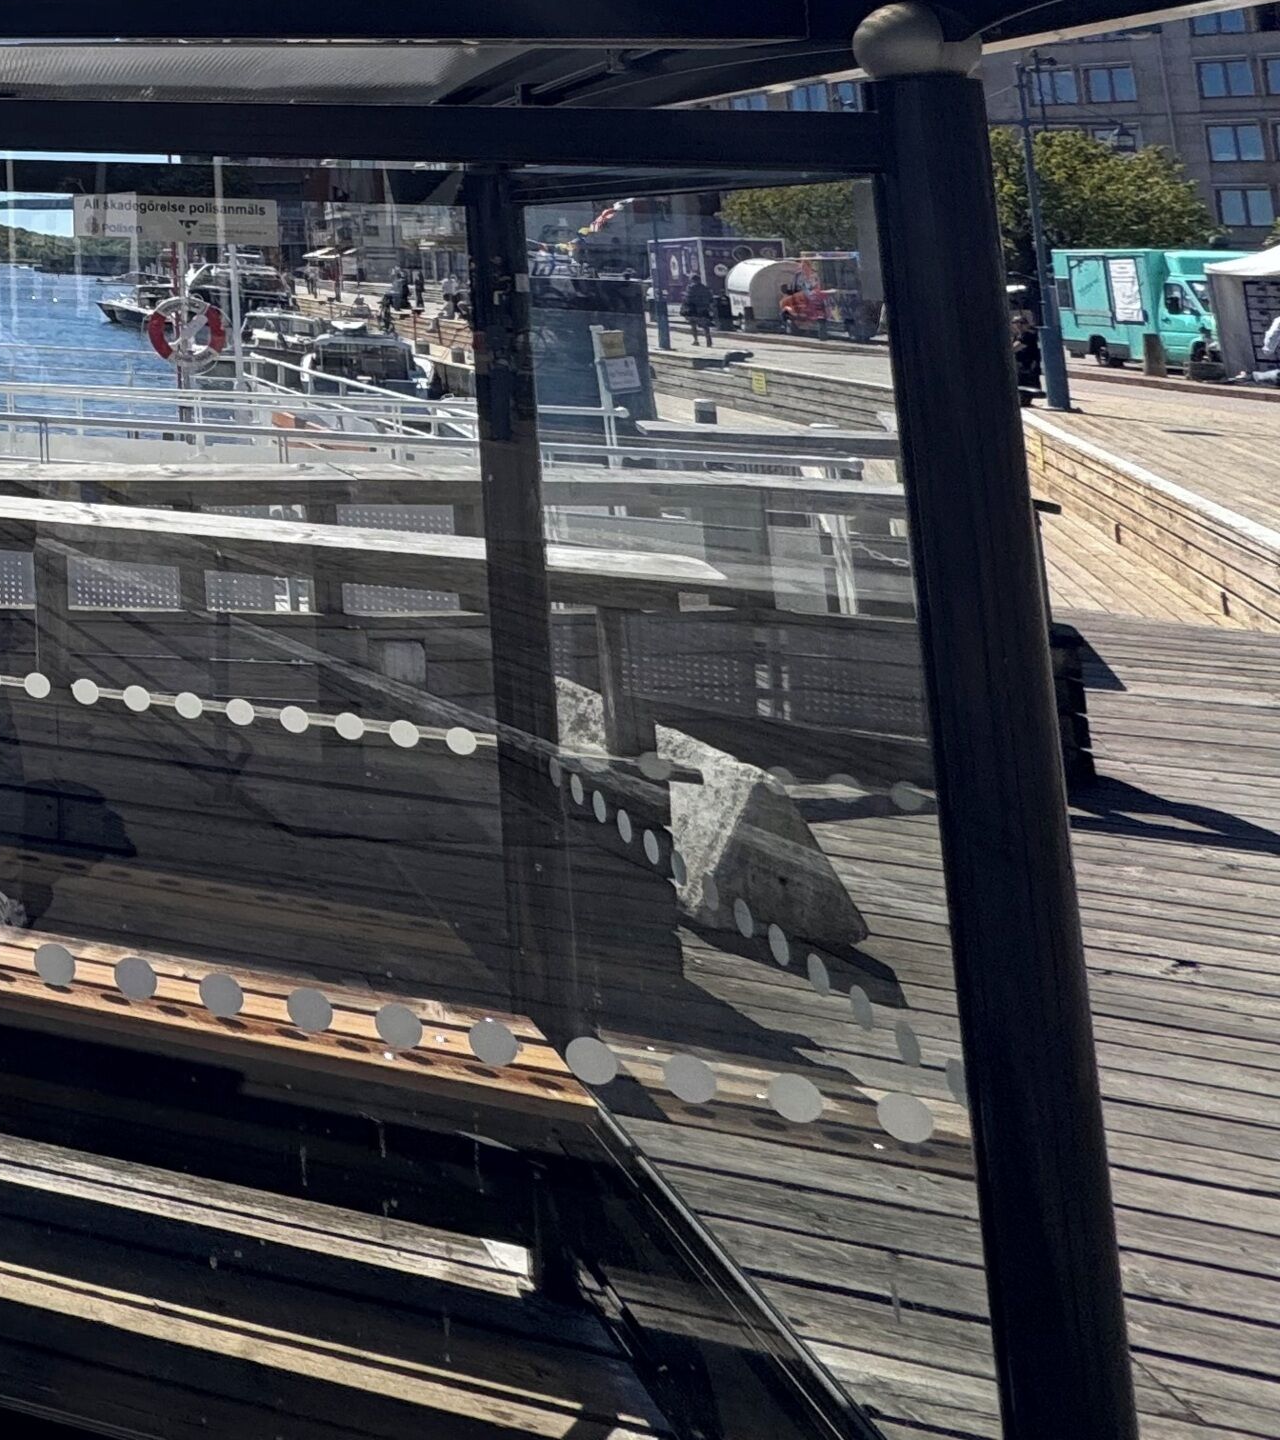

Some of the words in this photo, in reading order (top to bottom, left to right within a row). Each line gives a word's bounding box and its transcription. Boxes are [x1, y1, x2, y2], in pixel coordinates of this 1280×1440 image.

[83, 198, 99, 210] All
[103, 200, 185, 214] skadegörelse
[189, 202, 266, 216] polisanmäls
